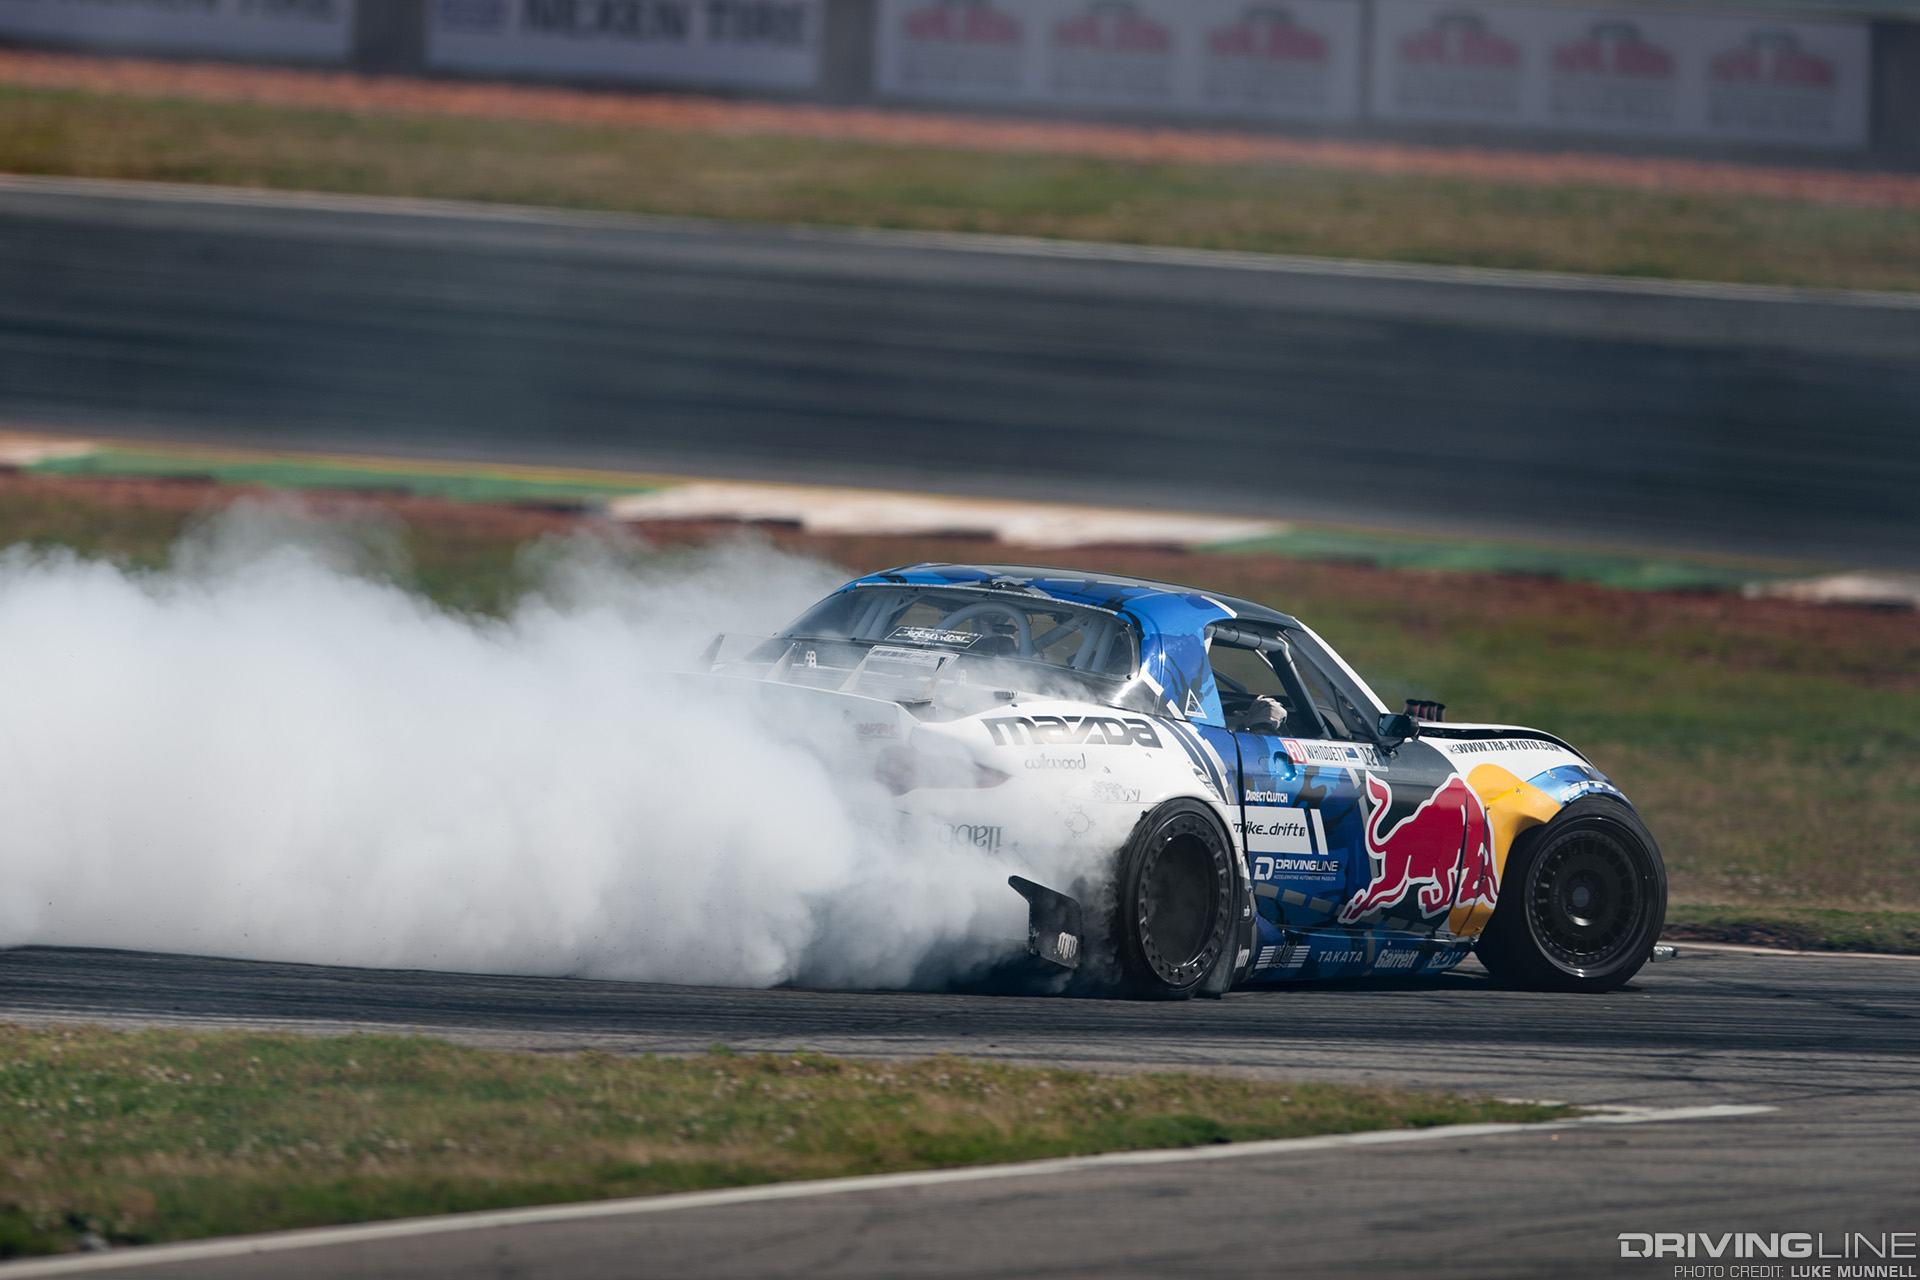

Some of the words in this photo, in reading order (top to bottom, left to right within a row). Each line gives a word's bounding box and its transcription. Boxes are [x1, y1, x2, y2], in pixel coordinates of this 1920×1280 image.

[1302, 743, 1346, 761] WHIDDETT
[1455, 740, 1562, 754] WWW.TRA-KYOTO.COM
[1245, 789, 1266, 802] DIRECT
[1275, 859, 1339, 872] DRIVINGLINE
[1318, 950, 1362, 963] TAKATA
[1374, 949, 1419, 968] Garrett
